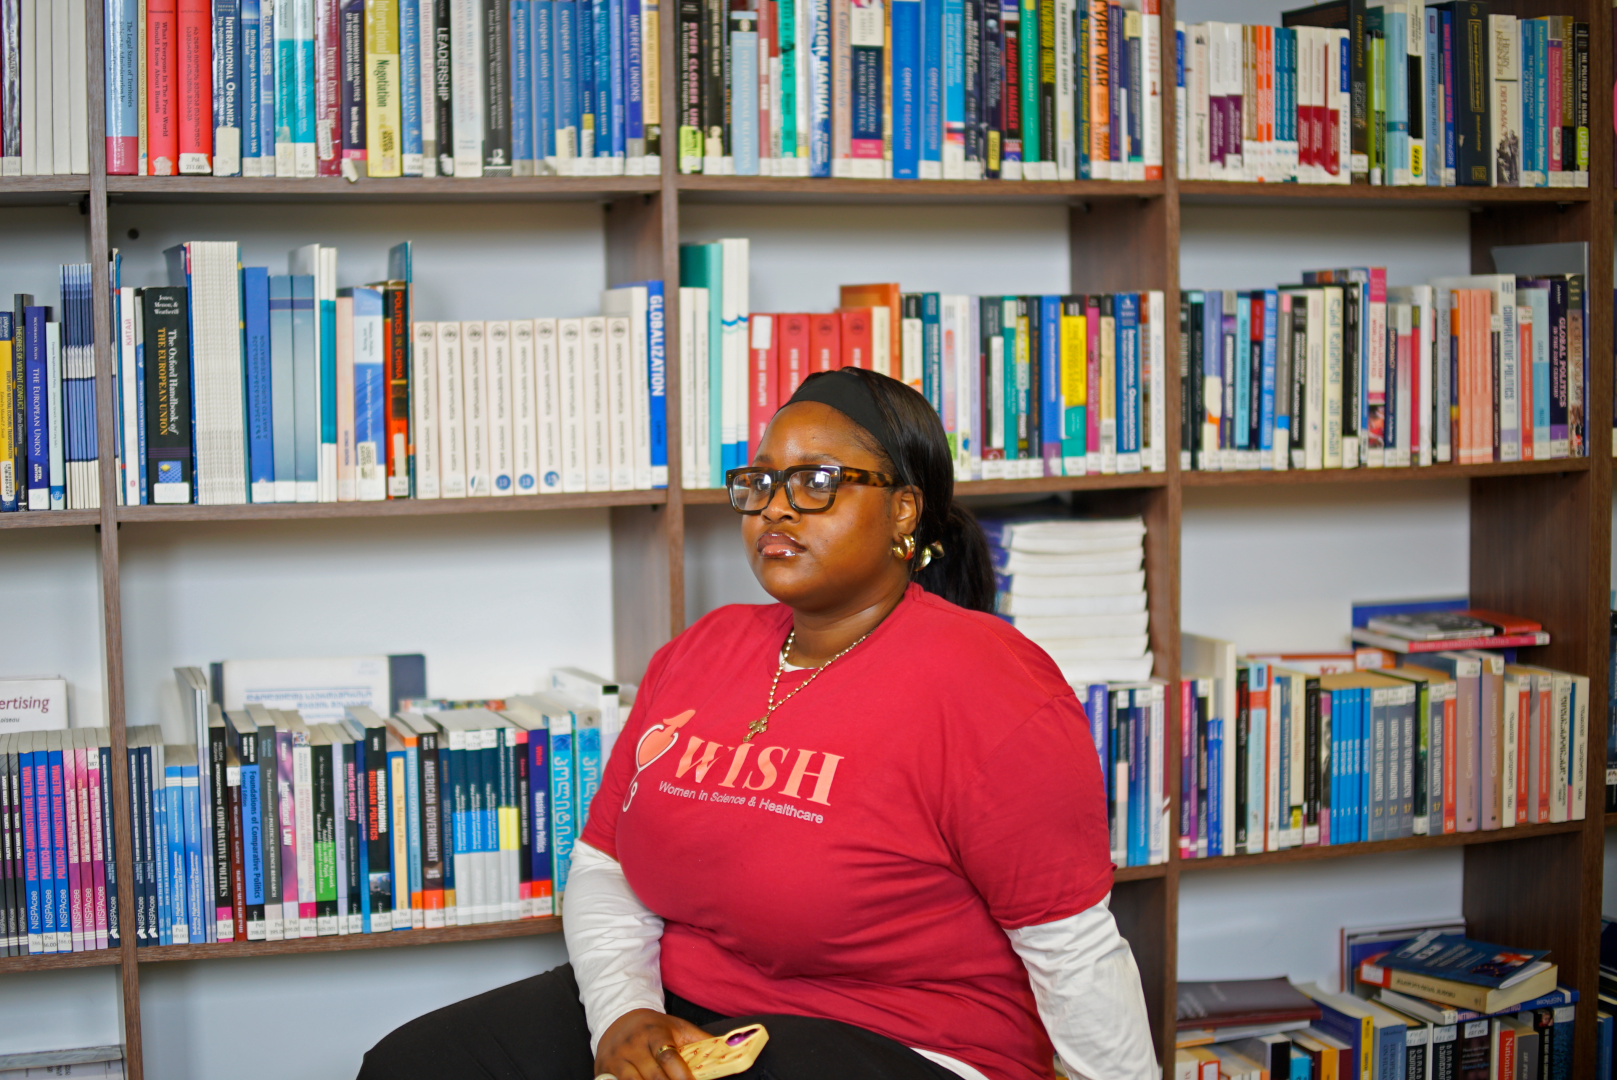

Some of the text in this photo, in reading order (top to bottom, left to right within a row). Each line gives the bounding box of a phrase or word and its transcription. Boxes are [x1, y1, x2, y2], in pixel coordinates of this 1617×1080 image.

[263, 16, 272, 76] GLOBAL ISSUES
[346, 13, 353, 21] OF
[515, 9, 526, 50] european
[538, 9, 548, 50] european
[560, 10, 570, 51] european
[1094, 0, 1108, 87] CYBER WAR
[162, 75, 168, 83] In
[226, 16, 235, 127] INTERNATIONAL ORGANIZA
[373, 0, 390, 108] International Negotiation
[407, 8, 416, 123] PUBLIC ADMINISTRATION
[437, 28, 449, 101] LEADERSHIP
[518, 52, 526, 78] union
[540, 52, 549, 78] union
[562, 52, 571, 79] union
[630, 15, 641, 102] IMPERFECT UNIONS
[689, 23, 698, 127] EVER CLOSER UN
[1006, 37, 1018, 130] CAMPAIGN MANAGER
[858, 51, 867, 132] OF WORLD POLITICS
[868, 51, 876, 133] THE GLOBALIZATION
[903, 67, 911, 150] CONFLICT RESOLUTION
[1582, 93, 1588, 101] OF
[16, 326, 24, 352] THEORIES
[395, 291, 403, 379] POLITICS IN CHINA
[650, 295, 664, 396] GLOBALIZATION
[1559, 317, 1567, 408] GLOBAL POLITICS
[16, 361, 24, 383] VIOLENT
[16, 385, 24, 410] CONFLICT
[157, 328, 168, 435] THE EUROPEAN UNION
[168, 329, 179, 435] The Oxford Handbook of
[32, 368, 42, 456] THE EUROPEAN UNION
[535, 746, 543, 766] White
[676, 736, 845, 807] WISH
[23, 766, 37, 881] POLITICO-ADMINISTRATIVE DILEMMA
[37, 765, 52, 880] POLITICO-ADMINISTRATIVE DILEMMA
[52, 765, 66, 879] POLITICO-ADMINISTRATIVE DILEMMA
[281, 782, 291, 846] International LAW
[346, 763, 357, 821] market society
[368, 770, 378, 841] RUSSIAN POLITICS
[376, 770, 387, 833] UNDERSTANDING
[424, 760, 438, 862] AMERICAN GOVERNMENT
[535, 791, 547, 853] Russia's New Politics
[554, 757, 571, 855] პოლიტიკა
[659, 781, 824, 824] Women in Science & Healthcare
[216, 806, 228, 897] COMPARATIVE POLITICS
[249, 771, 262, 899] Foundations of Comparative Politics
[30, 891, 38, 929] NISPAcee
[44, 890, 53, 928] NISPAcee
[59, 889, 68, 928] NISPAcee
[72, 889, 80, 928] NISPAcee
[84, 888, 92, 927] NISPAcee
[97, 886, 105, 926] NISPAcee
[148, 896, 156, 928] NISPAcee
